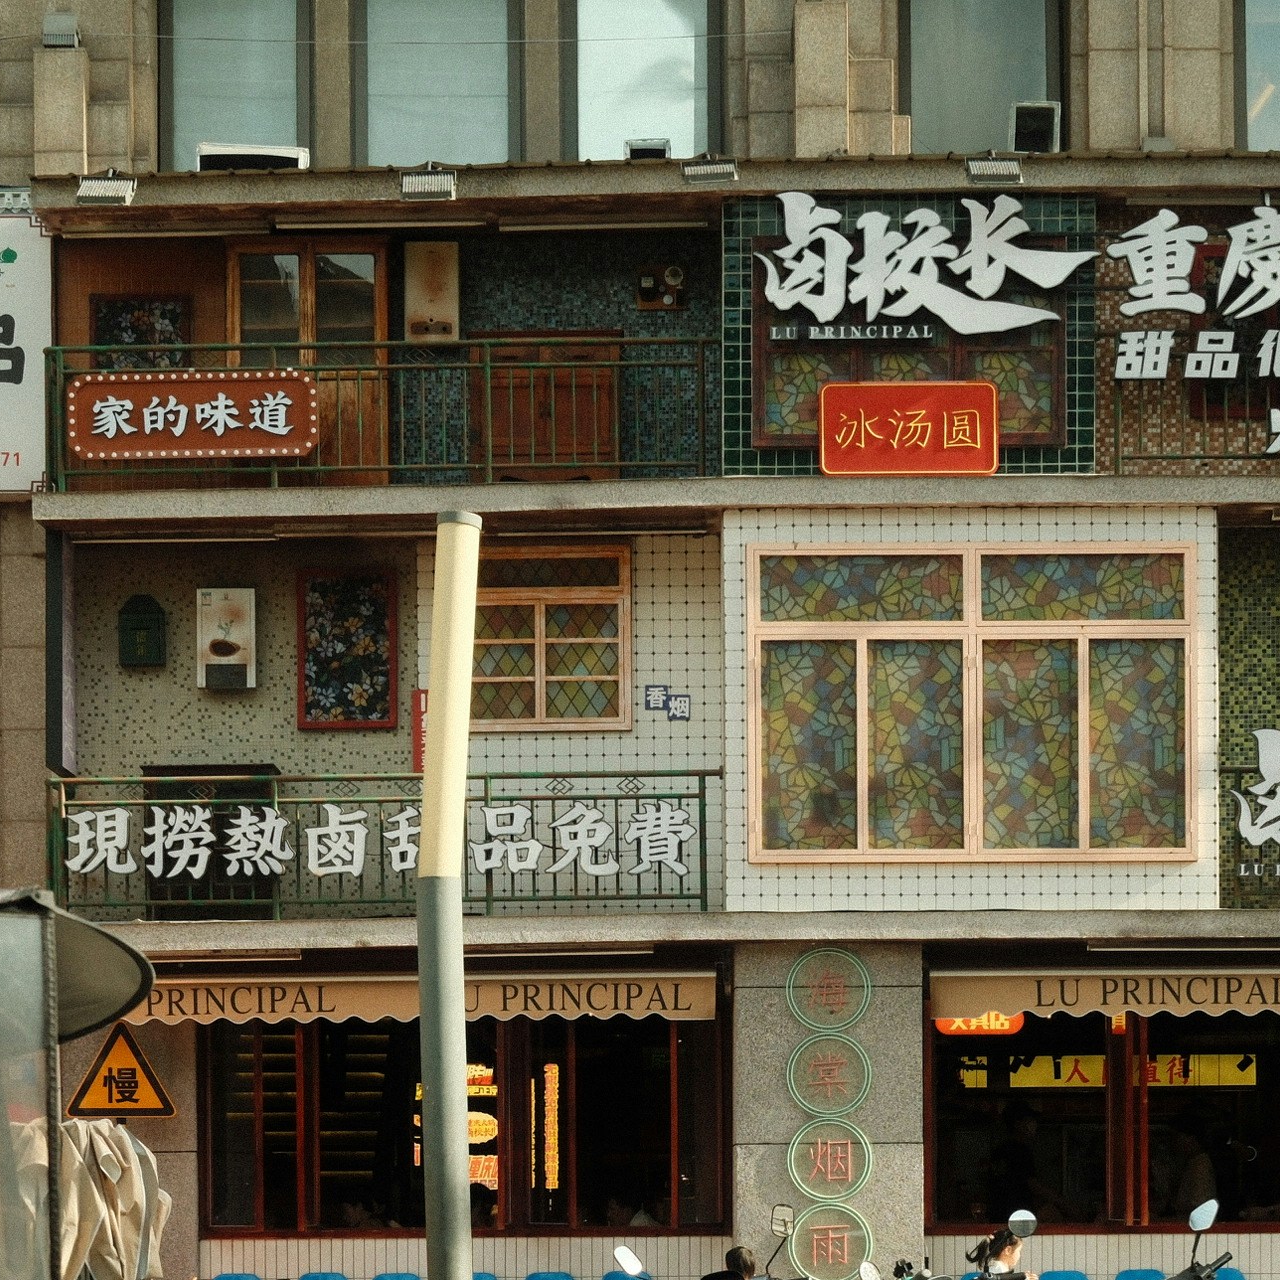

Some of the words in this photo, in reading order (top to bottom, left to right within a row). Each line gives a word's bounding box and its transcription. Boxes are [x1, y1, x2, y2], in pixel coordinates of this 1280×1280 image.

[771, 326, 798, 340] LU
[808, 324, 934, 340] PRINCIPAL
[91, 391, 294, 439] 家的味道
[835, 408, 982, 449] 冰汤圆
[646, 687, 690, 718] 香烟
[1239, 863, 1265, 876] LU
[145, 986, 337, 1017] PRINCIPAL
[498, 981, 693, 1014] PRINCIPAL
[1034, 978, 1082, 1007] LU
[101, 1067, 140, 1104] 慢
